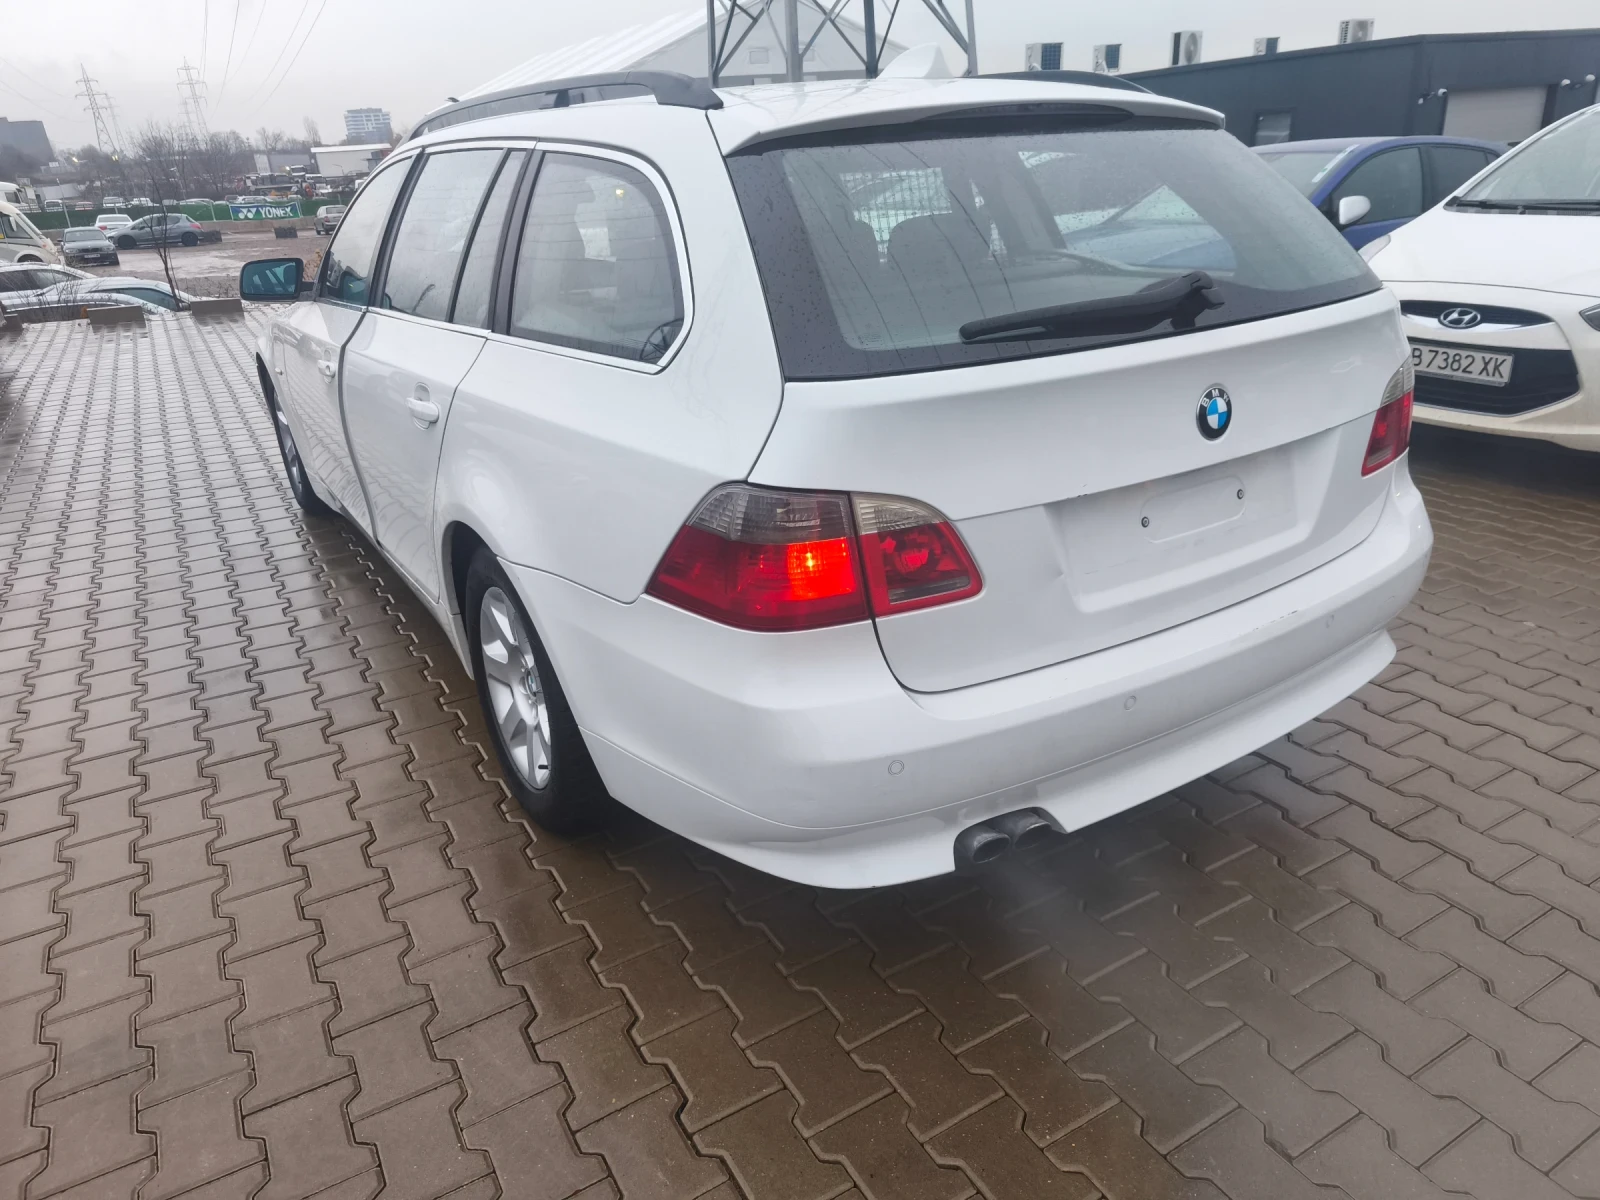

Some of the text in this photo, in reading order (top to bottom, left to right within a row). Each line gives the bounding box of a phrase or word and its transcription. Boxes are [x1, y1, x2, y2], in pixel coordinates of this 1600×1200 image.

[259, 206, 294, 218] YONEX
[1425, 349, 1476, 375] 7382
[1478, 355, 1508, 379] XK
[1201, 388, 1230, 408] BMW
